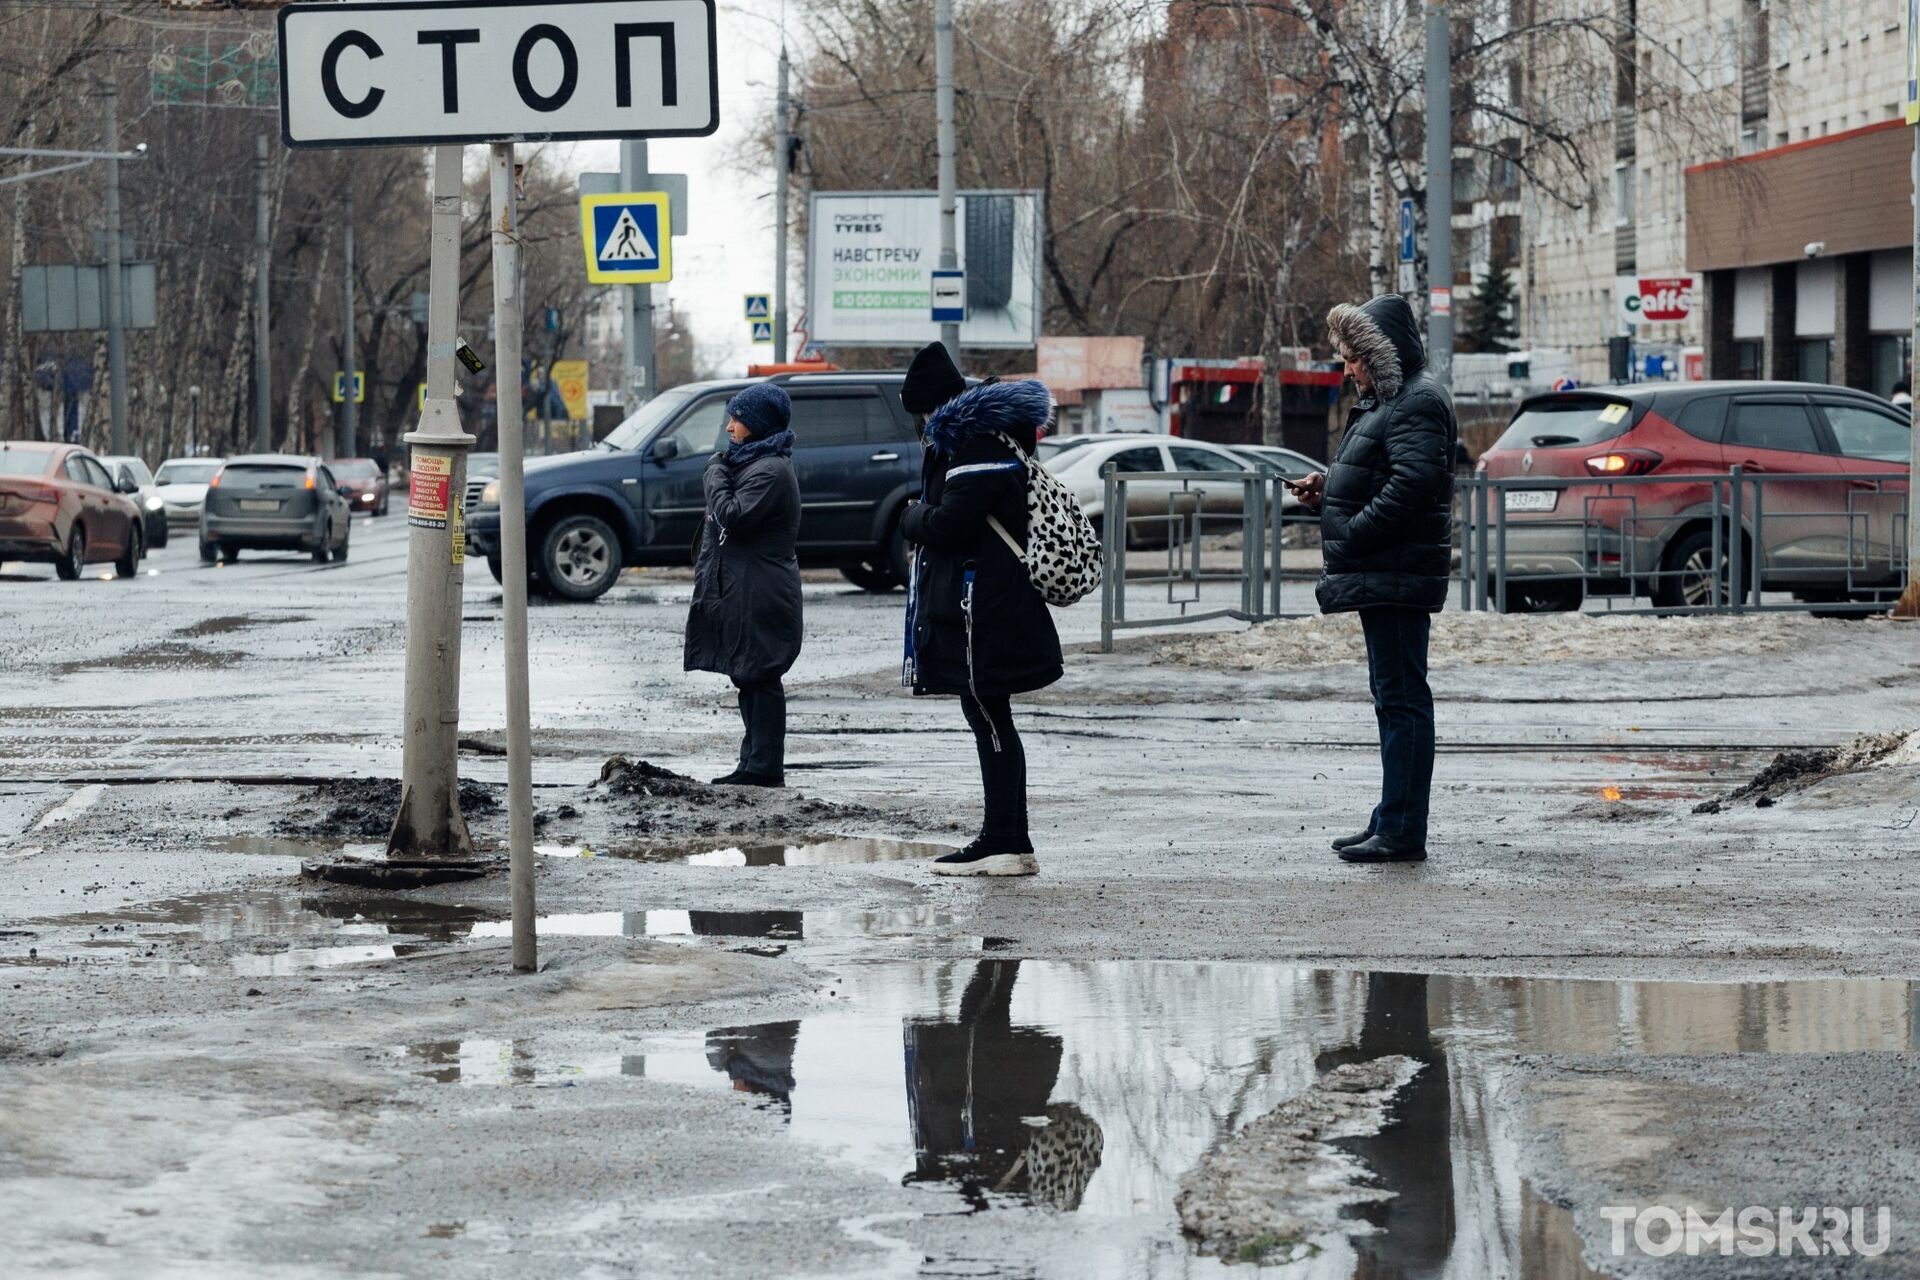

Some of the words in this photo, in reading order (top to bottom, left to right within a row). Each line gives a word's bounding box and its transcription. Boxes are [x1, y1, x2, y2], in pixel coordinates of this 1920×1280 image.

[321, 21, 677, 118] СТОП
[835, 223, 882, 233] TYRES
[833, 247, 921, 262] НАВСТРЕЧУ
[833, 267, 921, 282] ЭКОНОМИИ
[415, 456, 445, 466] ПОМОЩЬ
